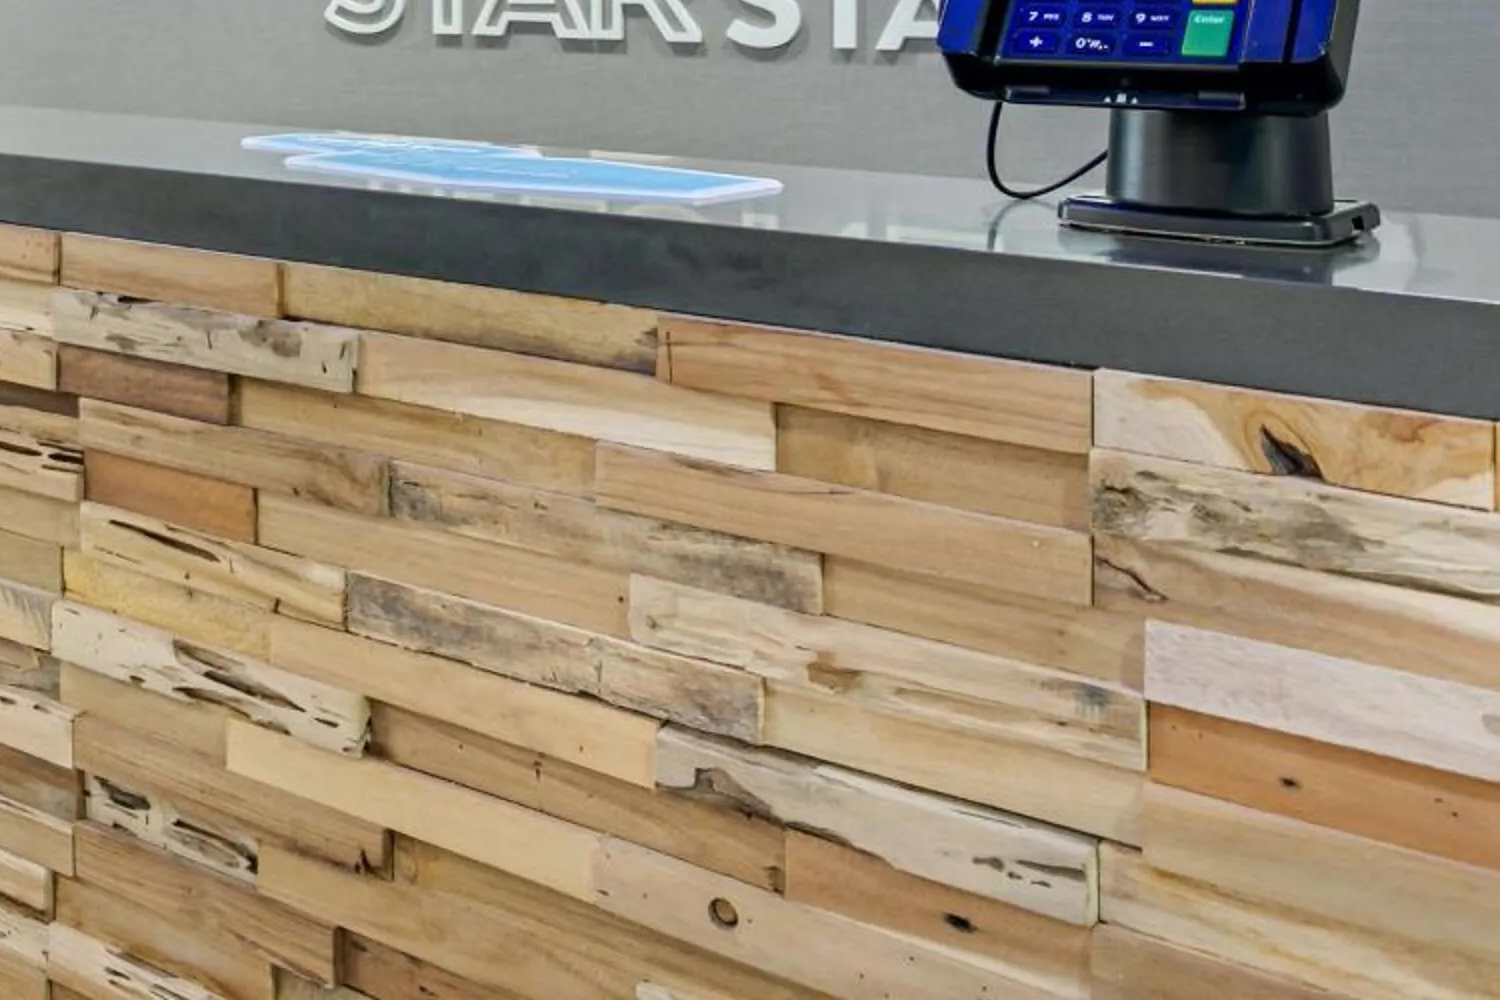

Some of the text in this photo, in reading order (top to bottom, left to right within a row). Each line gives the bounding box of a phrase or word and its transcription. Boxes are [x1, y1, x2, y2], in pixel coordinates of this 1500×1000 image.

[1027, 10, 1039, 22] 7
[1081, 11, 1093, 23] 8
[1135, 12, 1147, 24] 9
